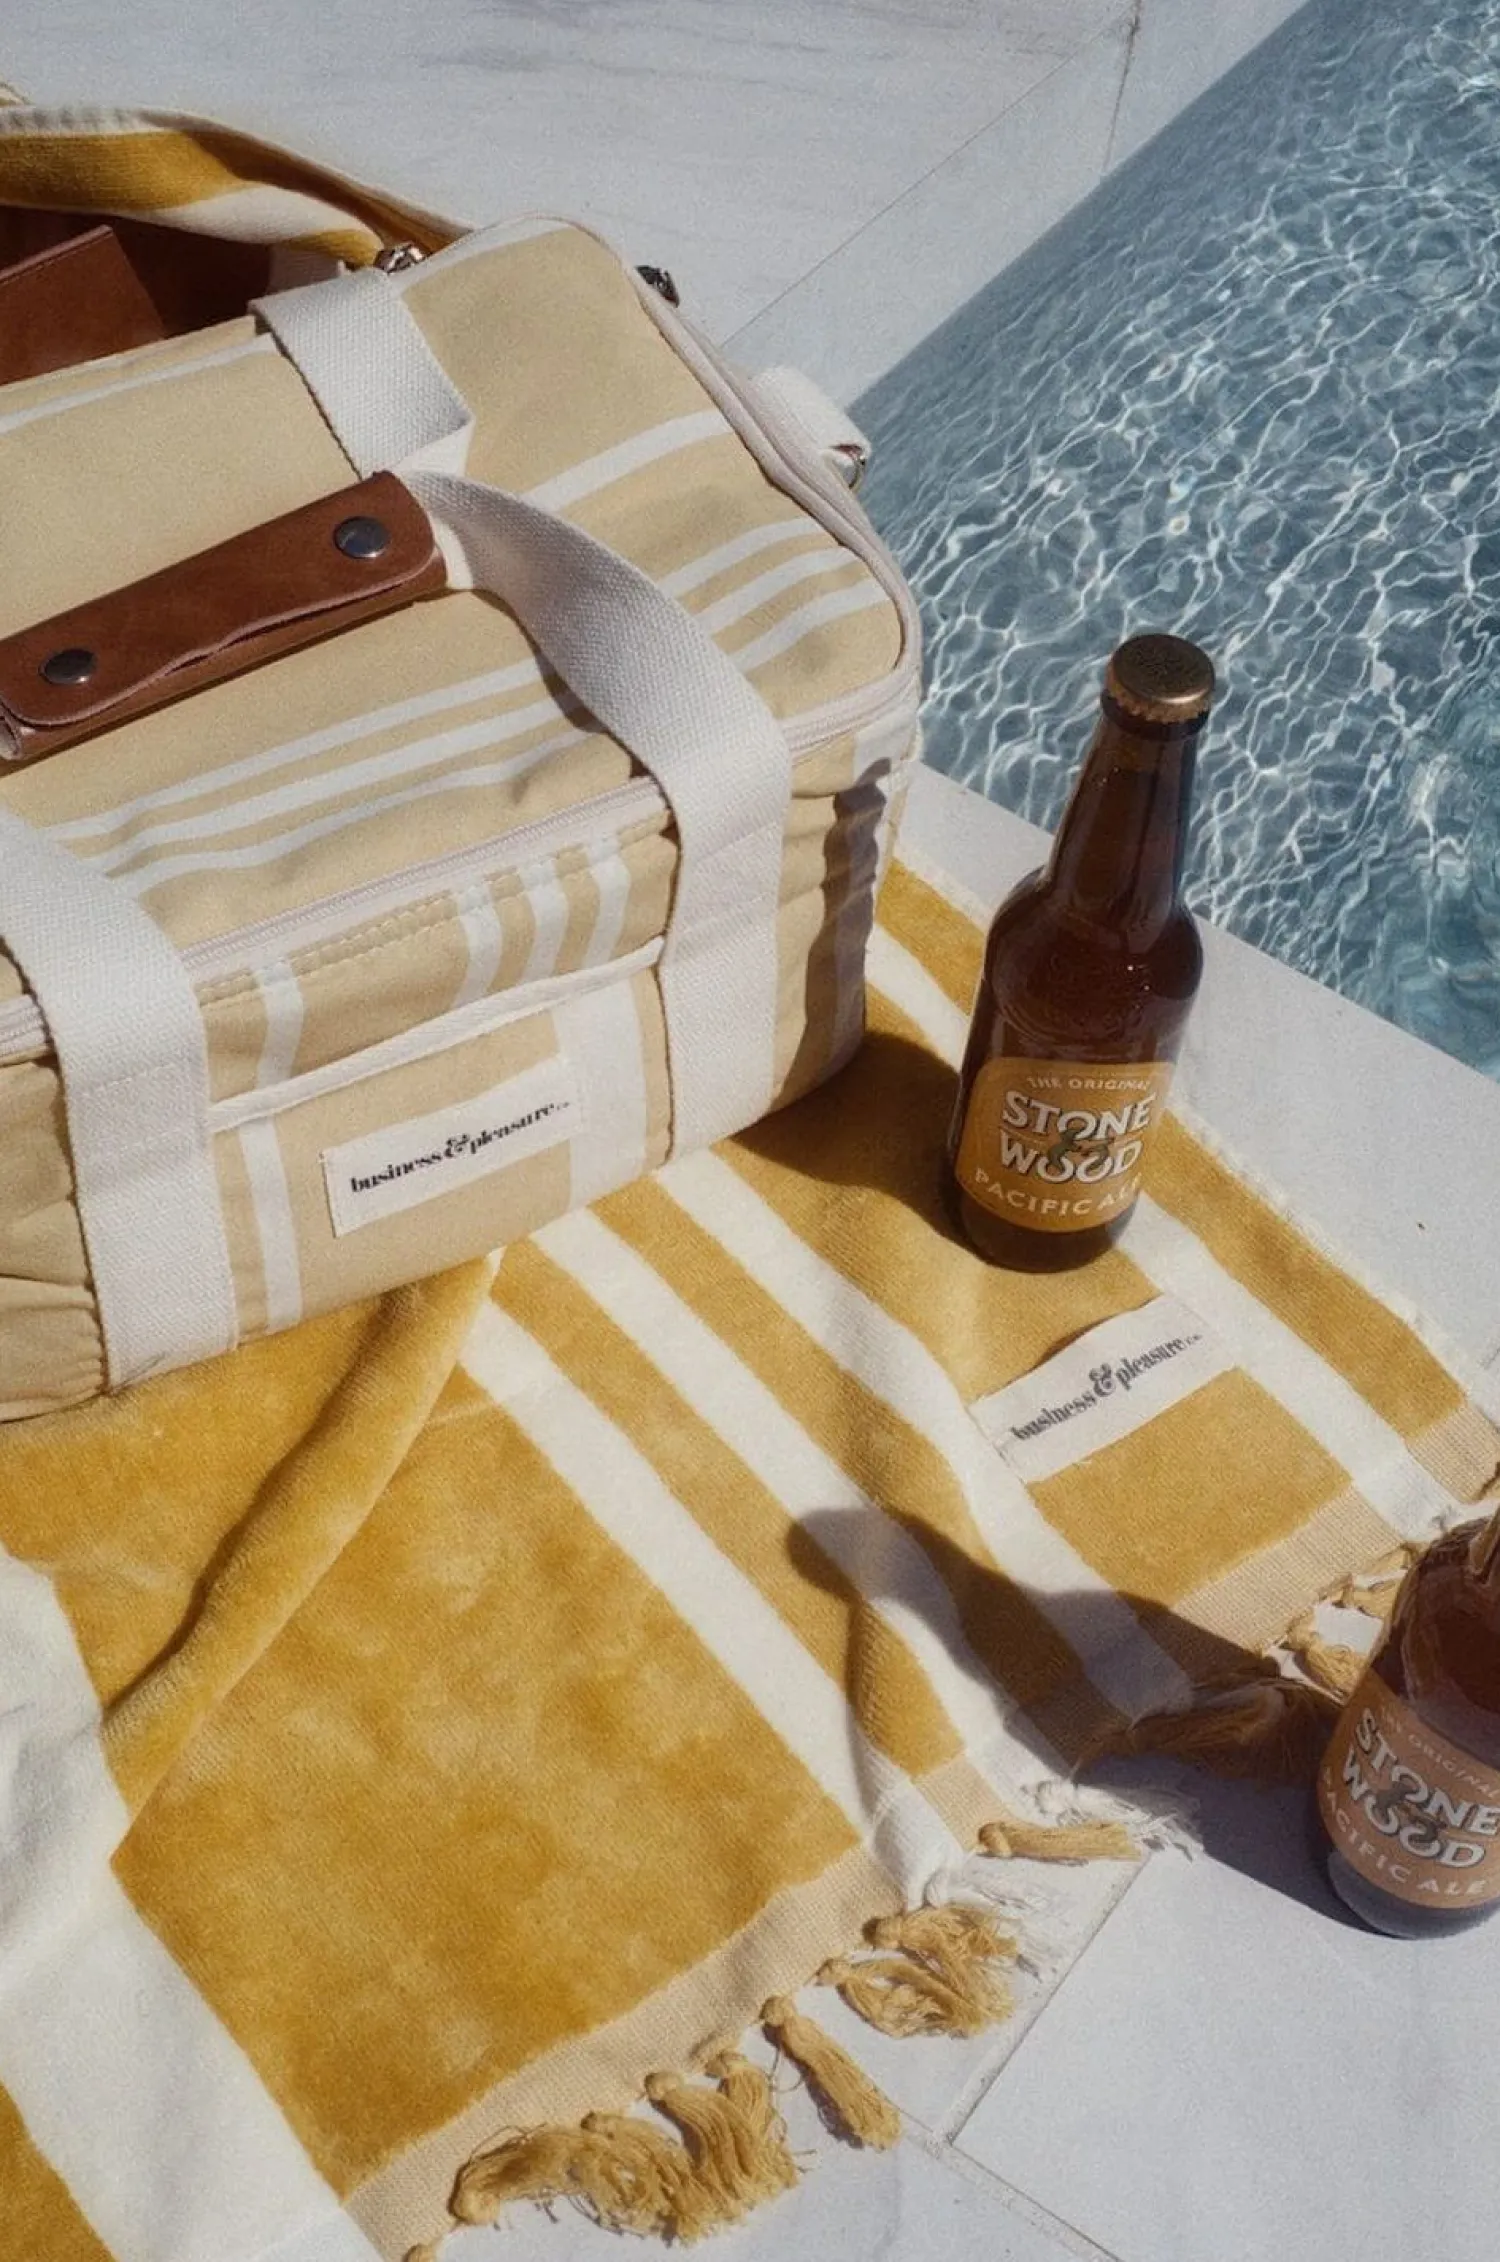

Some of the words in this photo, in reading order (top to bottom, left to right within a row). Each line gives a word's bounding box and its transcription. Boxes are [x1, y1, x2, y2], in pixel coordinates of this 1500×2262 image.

[1002, 1090, 1157, 1140] STONE
[999, 1130, 1143, 1183] WOOD
[975, 1168, 1093, 1216] PACIFIC
[1355, 1707, 1500, 1836] STONE
[1342, 1743, 1486, 1868] WOOD
[1417, 1877, 1487, 1895] ALE
